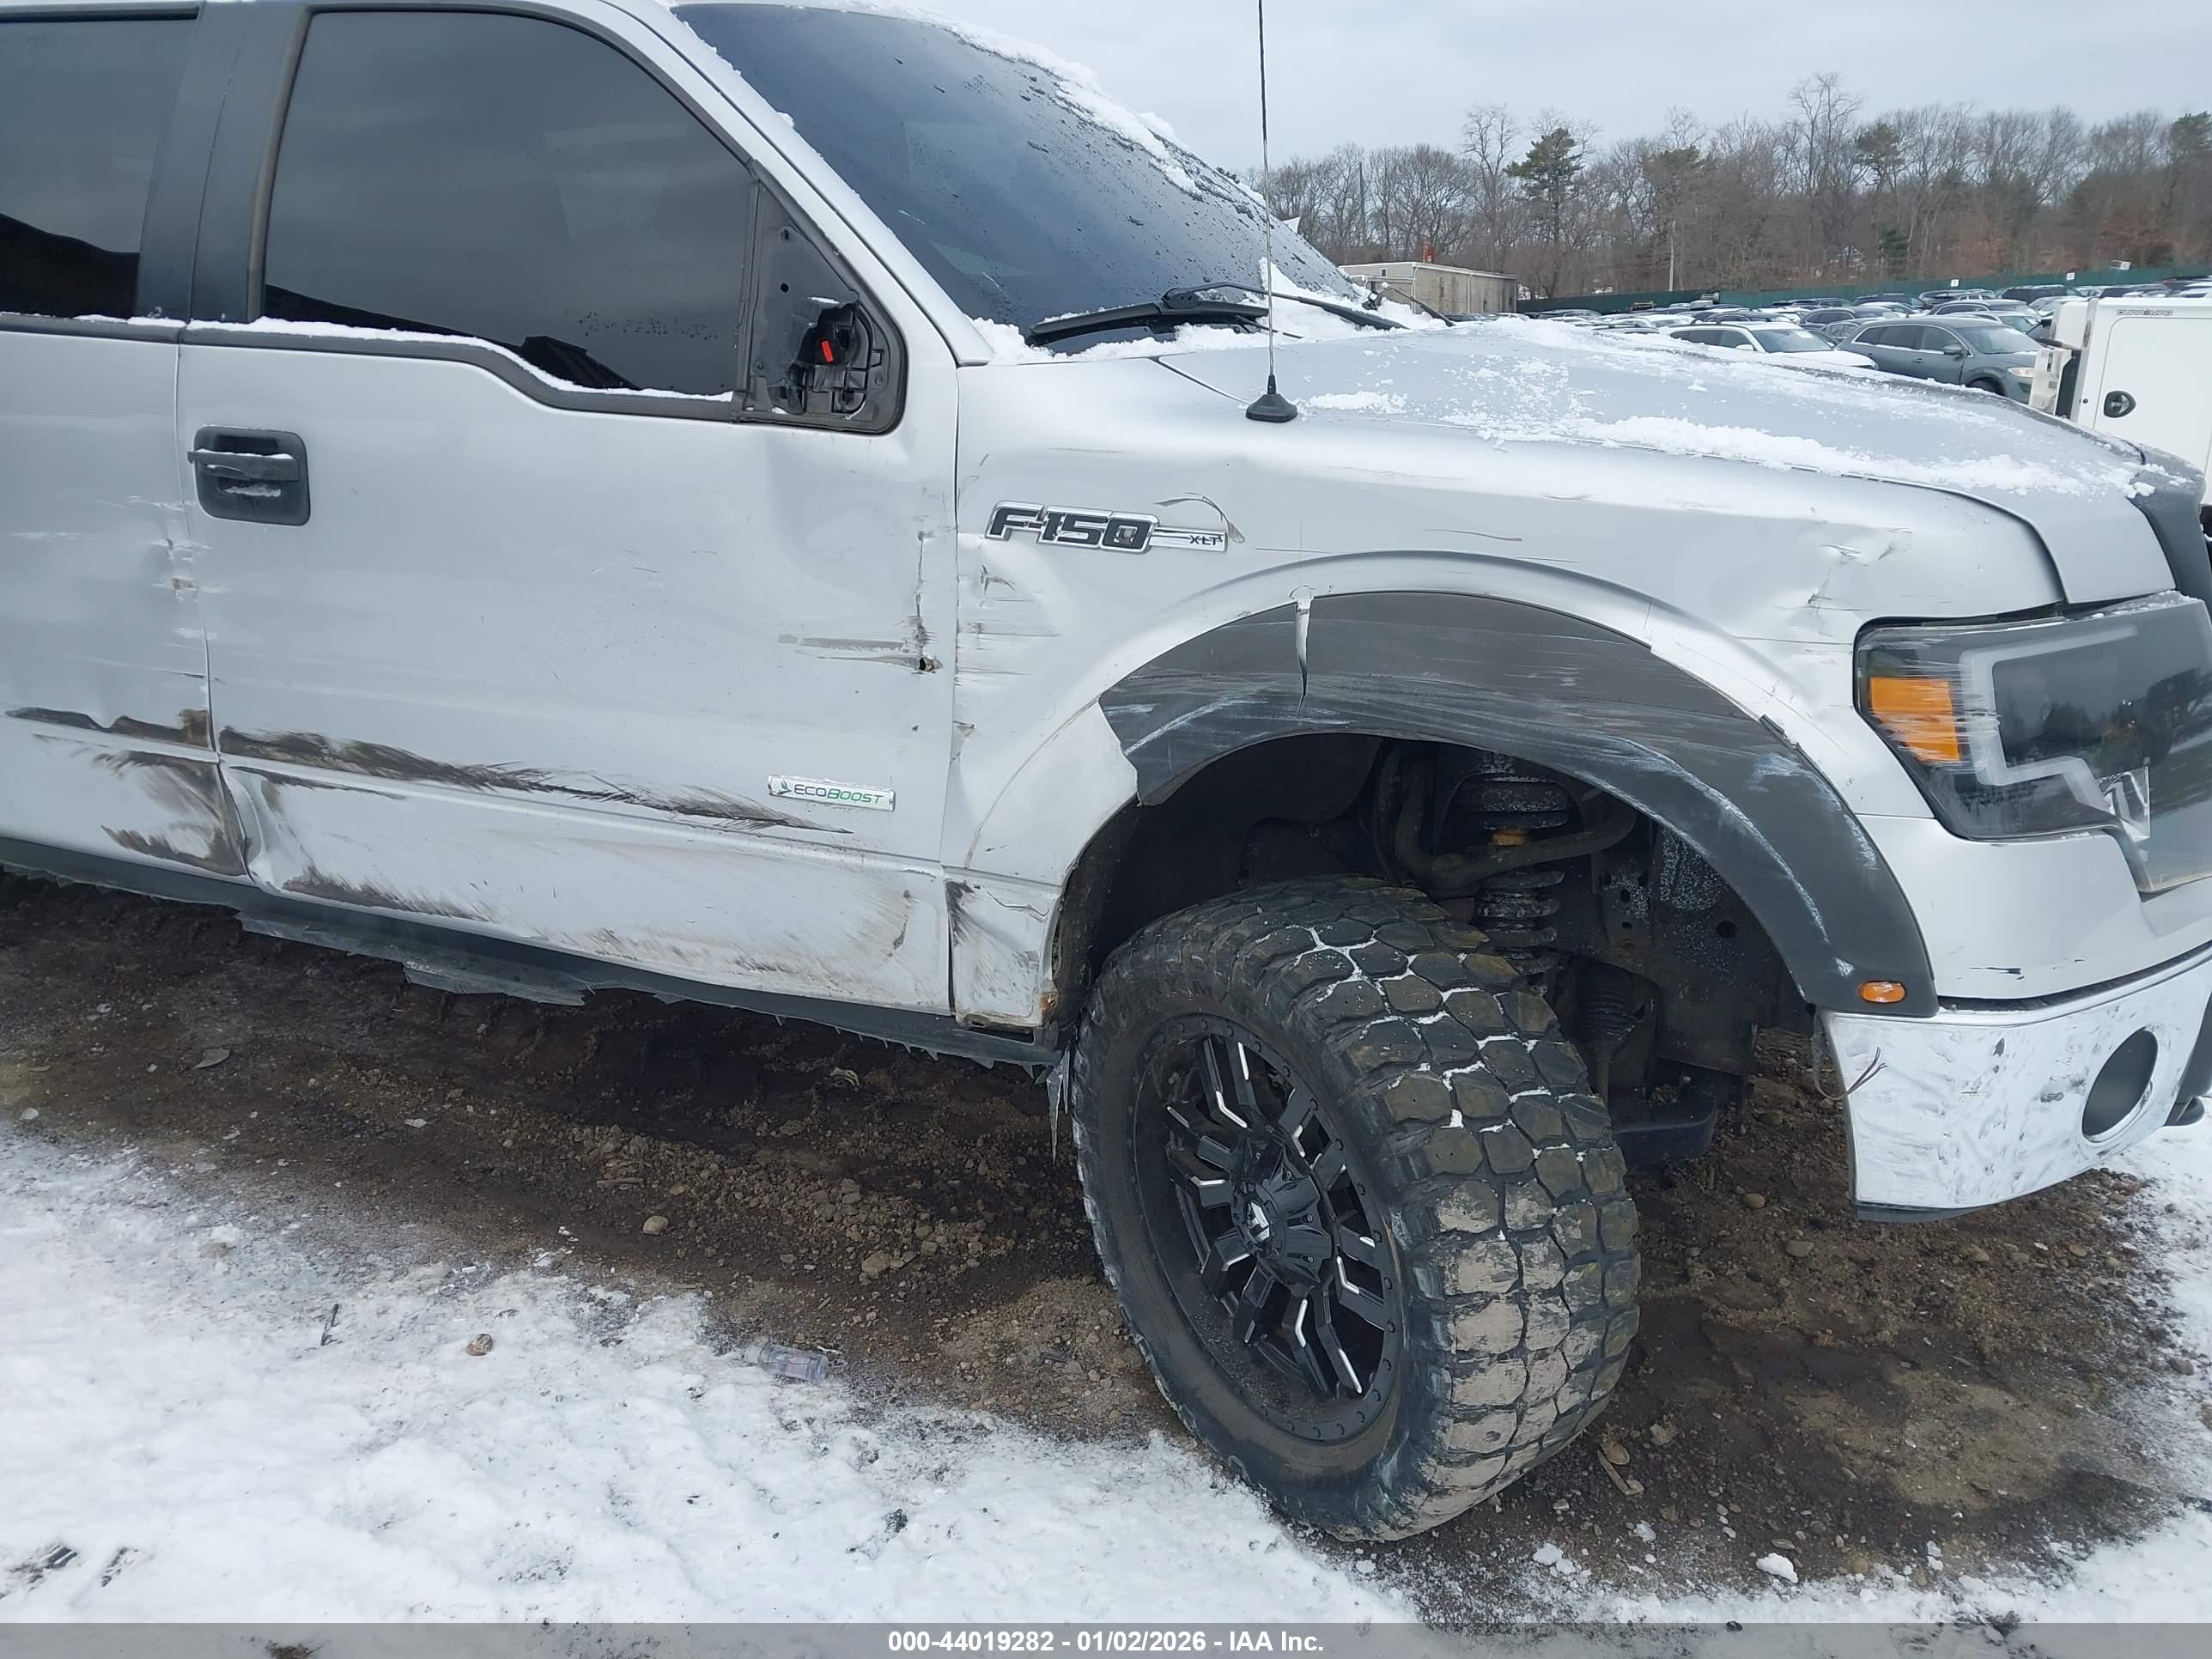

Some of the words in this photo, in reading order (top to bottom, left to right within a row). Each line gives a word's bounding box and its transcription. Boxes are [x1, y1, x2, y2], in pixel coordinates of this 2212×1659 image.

[986, 501, 1158, 552] F-150
[1188, 534, 1219, 546] XLT
[794, 784, 884, 804] ECOBOOST
